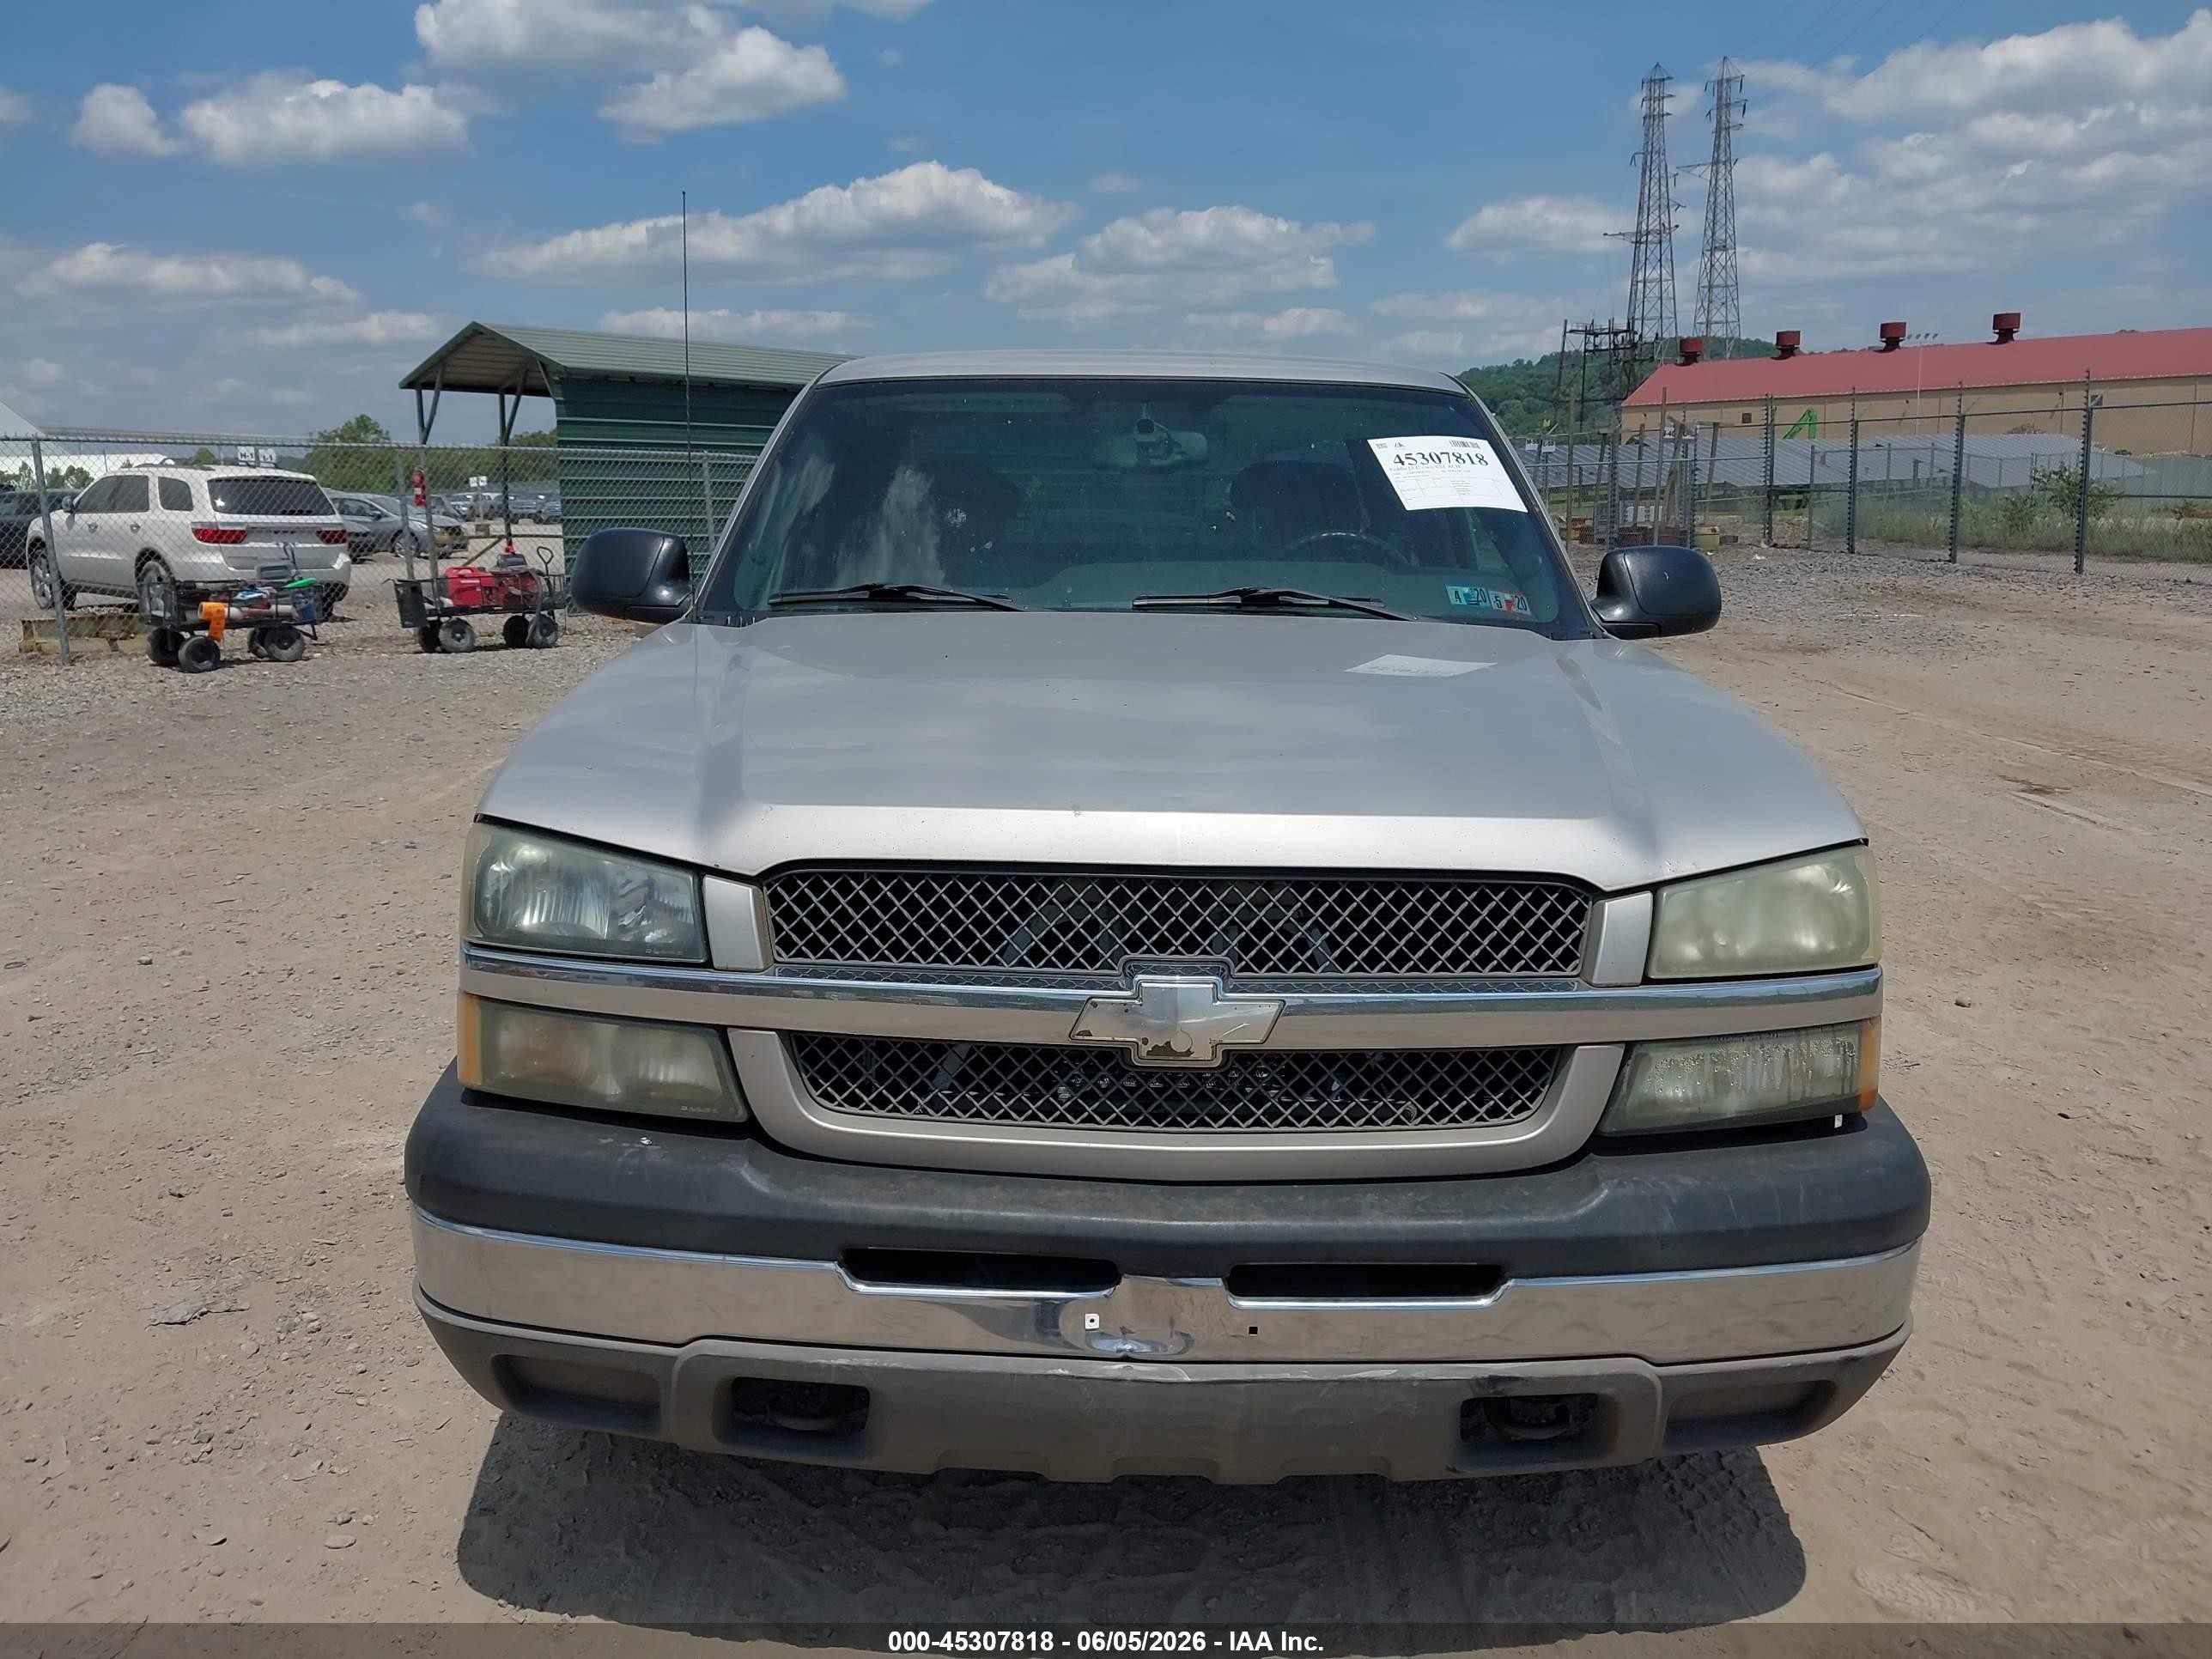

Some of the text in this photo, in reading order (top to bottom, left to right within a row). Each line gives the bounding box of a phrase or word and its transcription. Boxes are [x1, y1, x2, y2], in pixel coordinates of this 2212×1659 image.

[1393, 452, 1489, 466] 45307818
[1454, 588, 1487, 604] 4 20
[1514, 596, 1528, 611] 20
